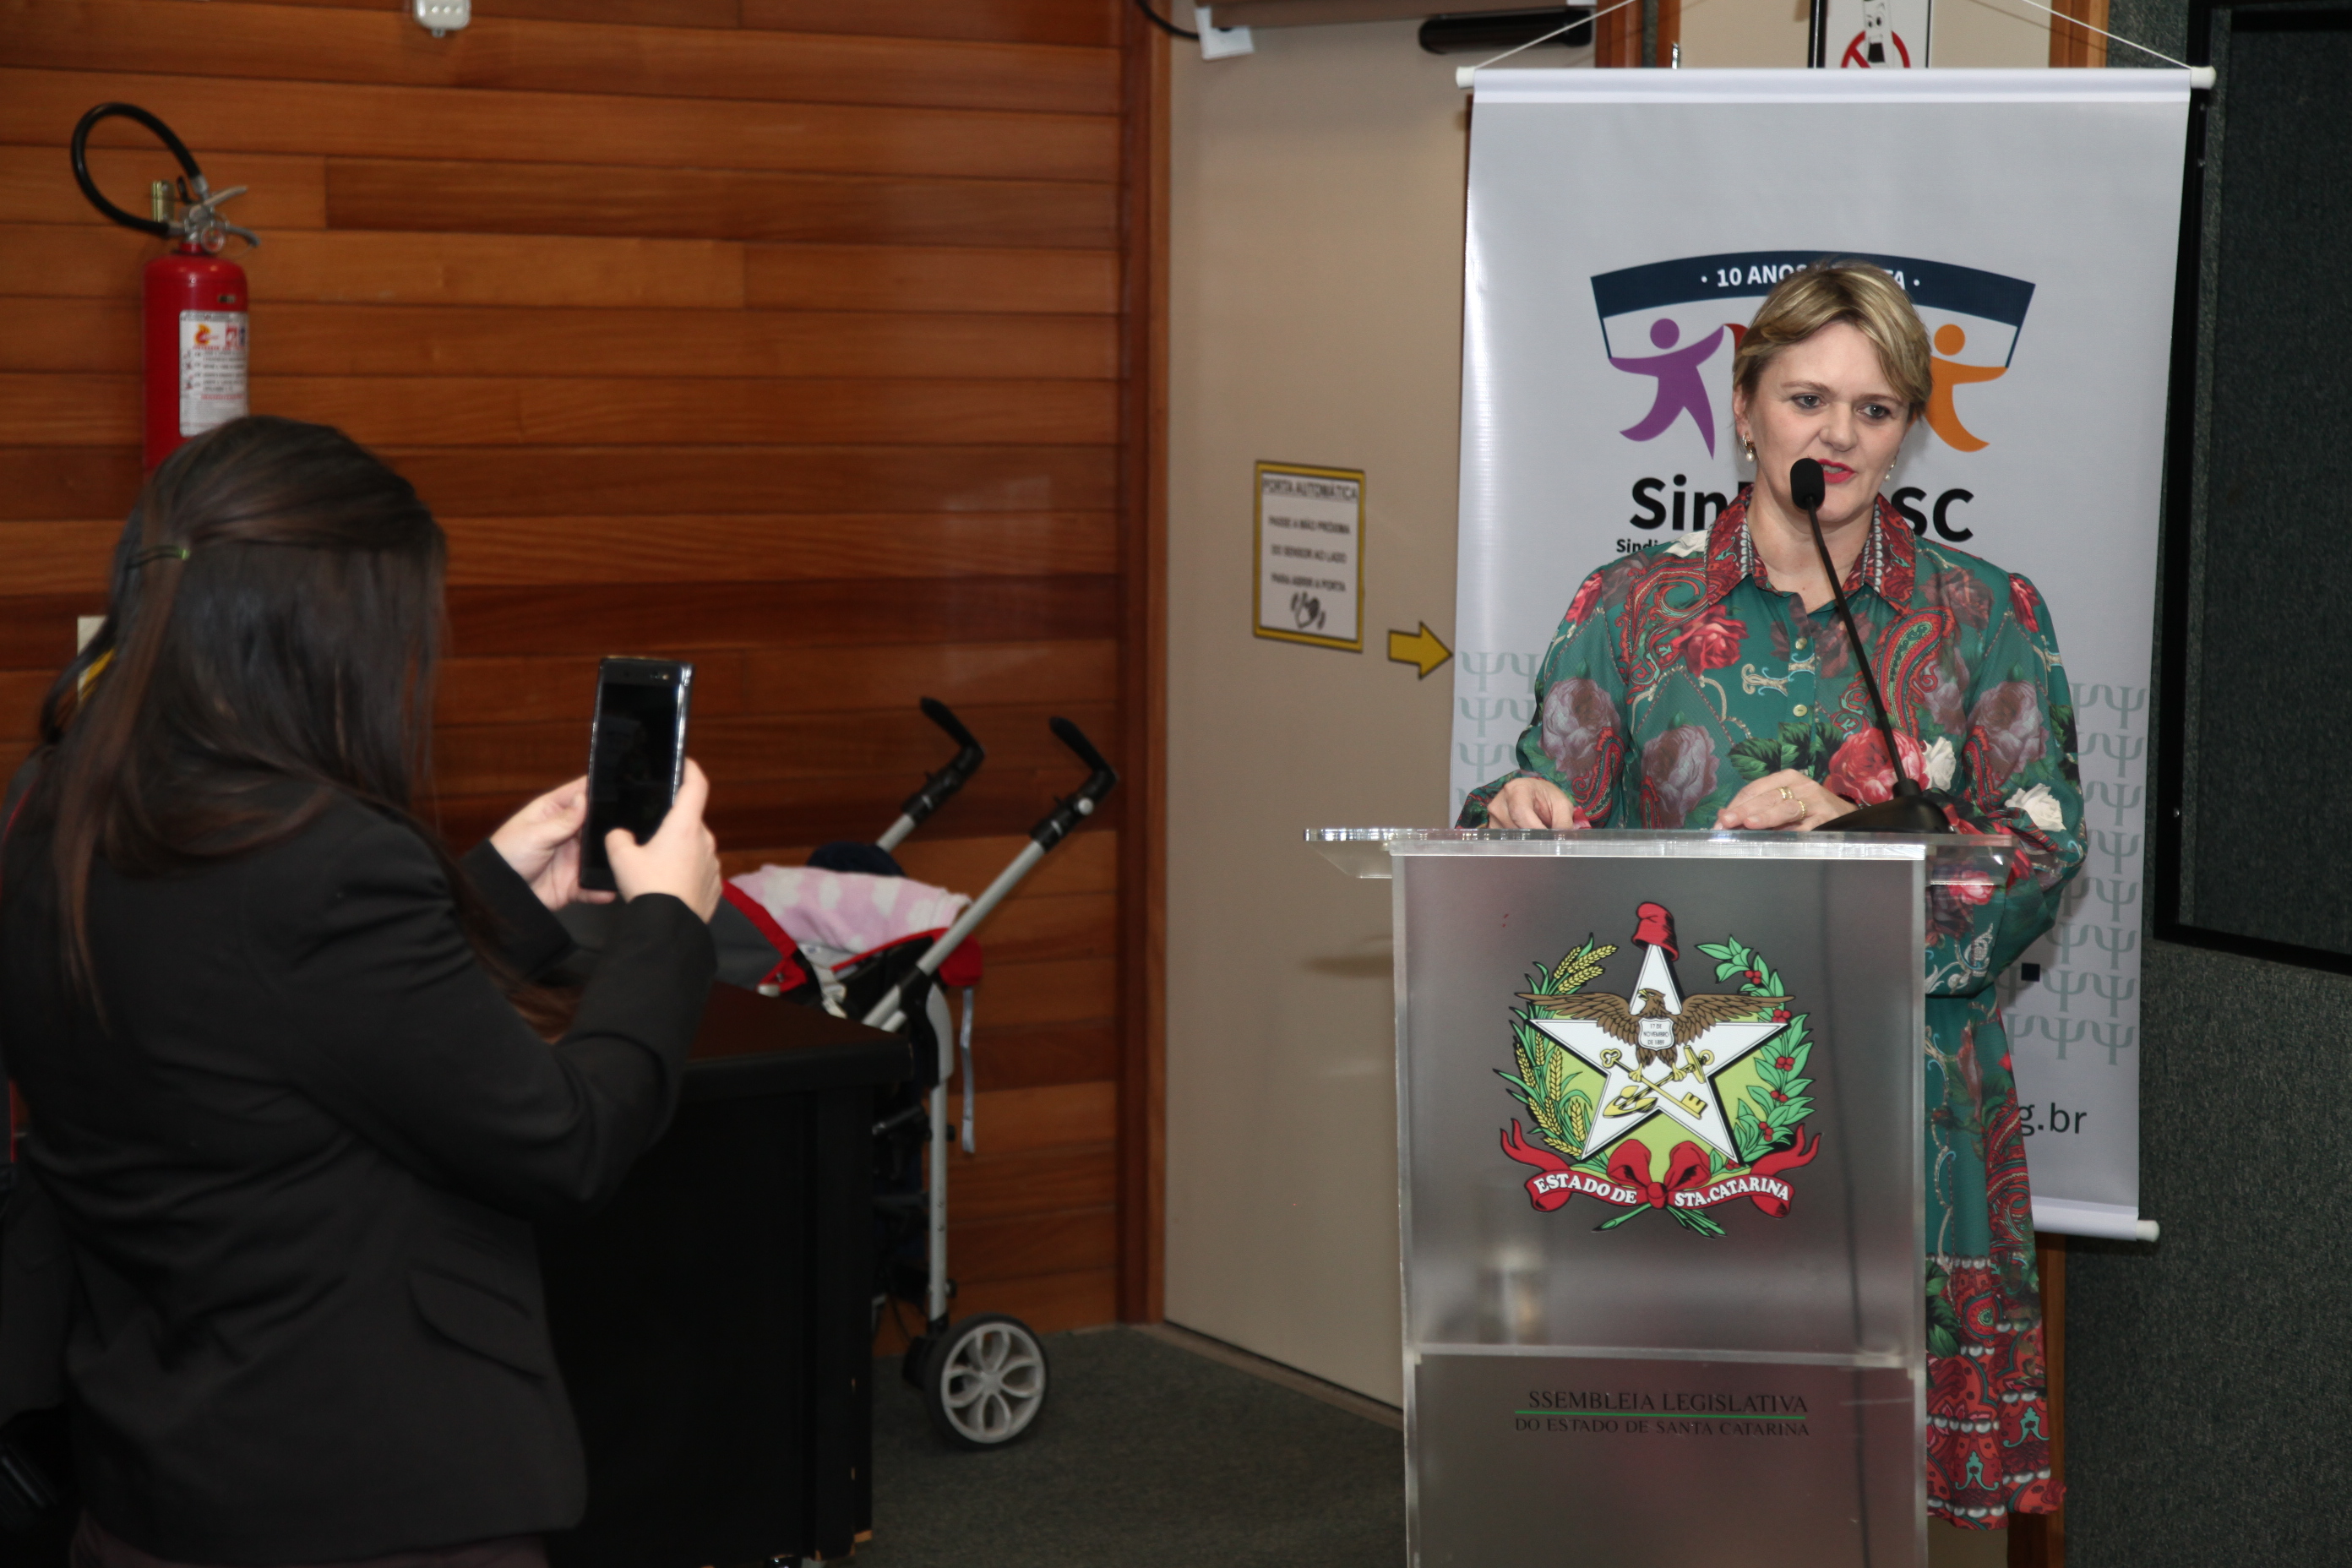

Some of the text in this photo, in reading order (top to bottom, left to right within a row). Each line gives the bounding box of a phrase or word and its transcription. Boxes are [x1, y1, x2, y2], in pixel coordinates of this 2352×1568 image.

[1717, 267, 1742, 287] 10
[1747, 264, 1807, 285] ANO
[1533, 1173, 1611, 1197] ESTADO
[1609, 1187, 1637, 1205] DE
[1529, 1391, 1808, 1413] SSEMBLEIA LEGISLATIVA
[1516, 1418, 1810, 1437] DO ESTADO DE SANTA CATARINA
